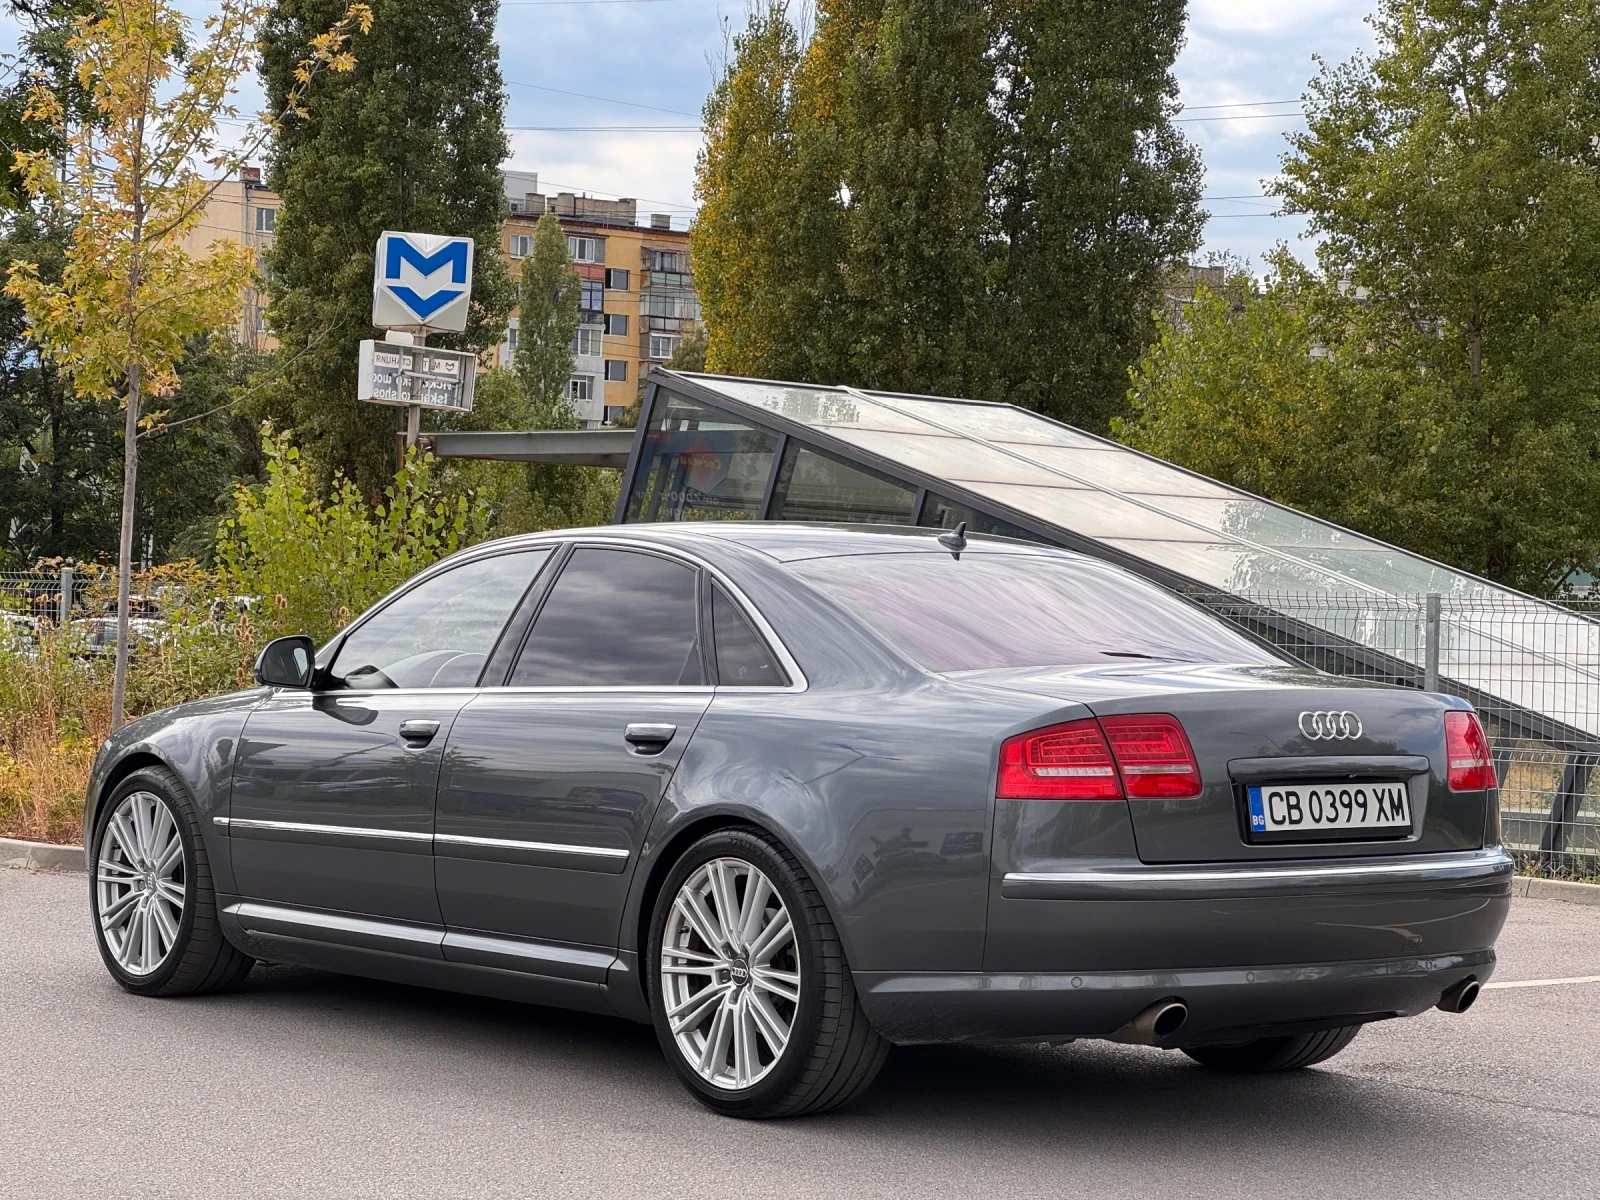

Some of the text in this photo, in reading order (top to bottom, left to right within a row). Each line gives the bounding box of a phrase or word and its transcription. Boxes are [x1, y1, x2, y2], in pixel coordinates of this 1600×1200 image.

[1268, 788, 1406, 826] CB 0399 XM
[1252, 815, 1265, 826] BG
